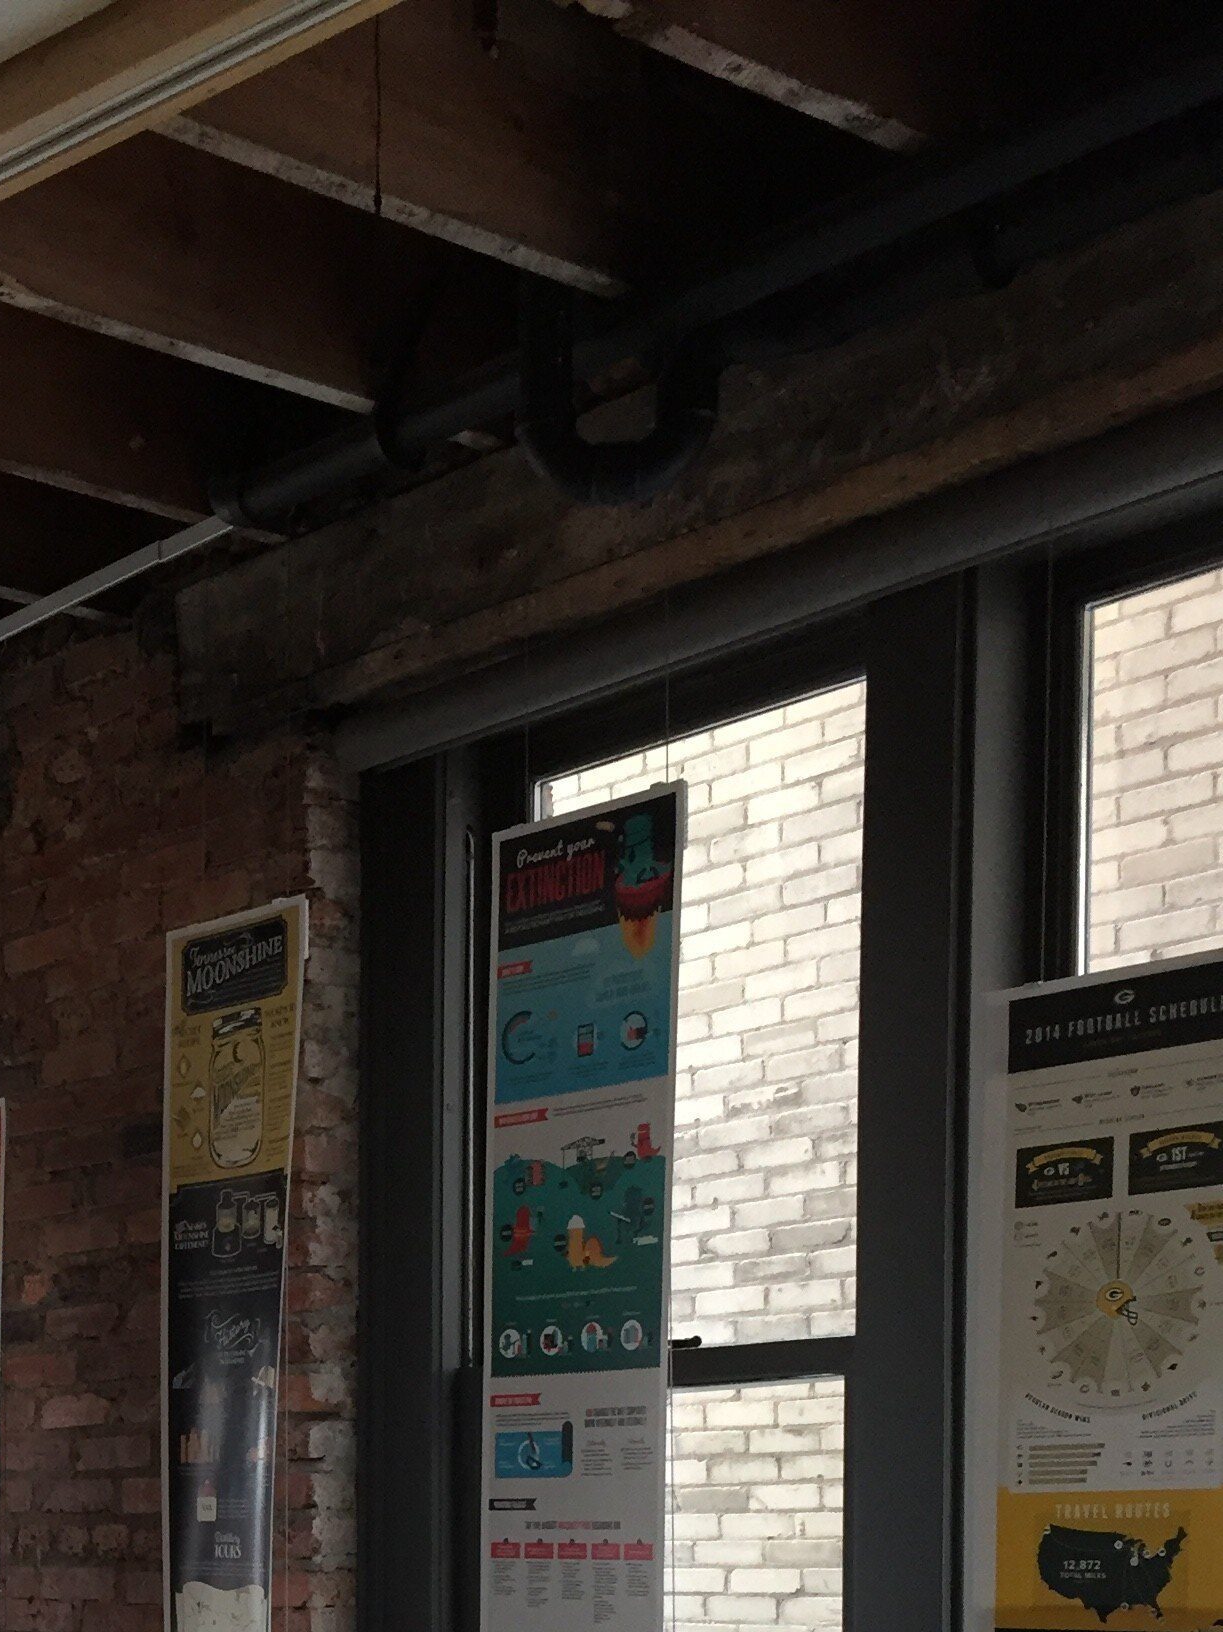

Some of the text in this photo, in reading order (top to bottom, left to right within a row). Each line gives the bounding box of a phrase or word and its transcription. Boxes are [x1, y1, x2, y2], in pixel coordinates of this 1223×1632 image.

[516, 837, 595, 868] Prevent your
[506, 850, 606, 914] EXTINCTION
[186, 935, 283, 997] MOONSHINE
[1024, 1024, 1061, 1045] 2014
[1067, 1009, 1141, 1039] FOOTBALL
[1055, 1502, 1171, 1519] TRAVEL ROUTES
